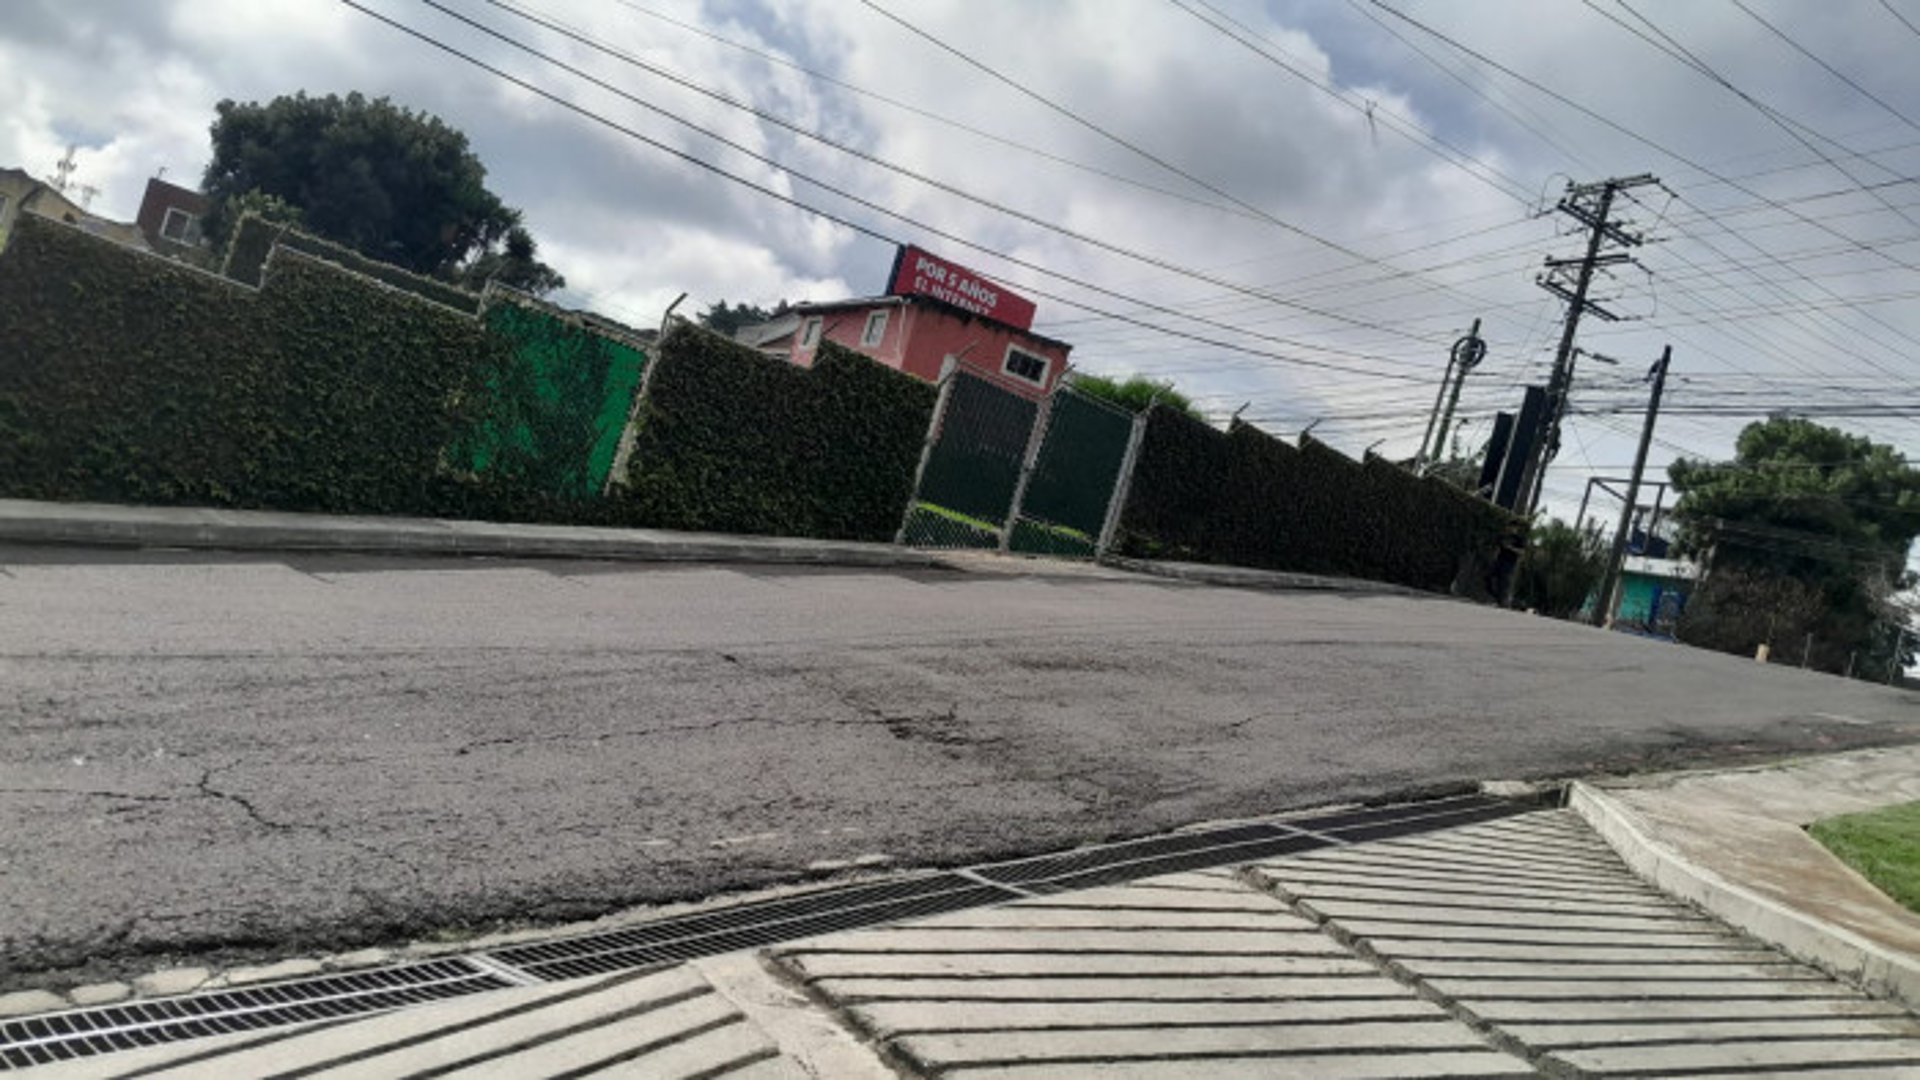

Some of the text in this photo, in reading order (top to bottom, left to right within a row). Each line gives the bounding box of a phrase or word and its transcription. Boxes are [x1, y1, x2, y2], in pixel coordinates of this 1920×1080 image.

[914, 276, 928, 292] EL
[916, 257, 997, 307] POR 5 AÑOS
